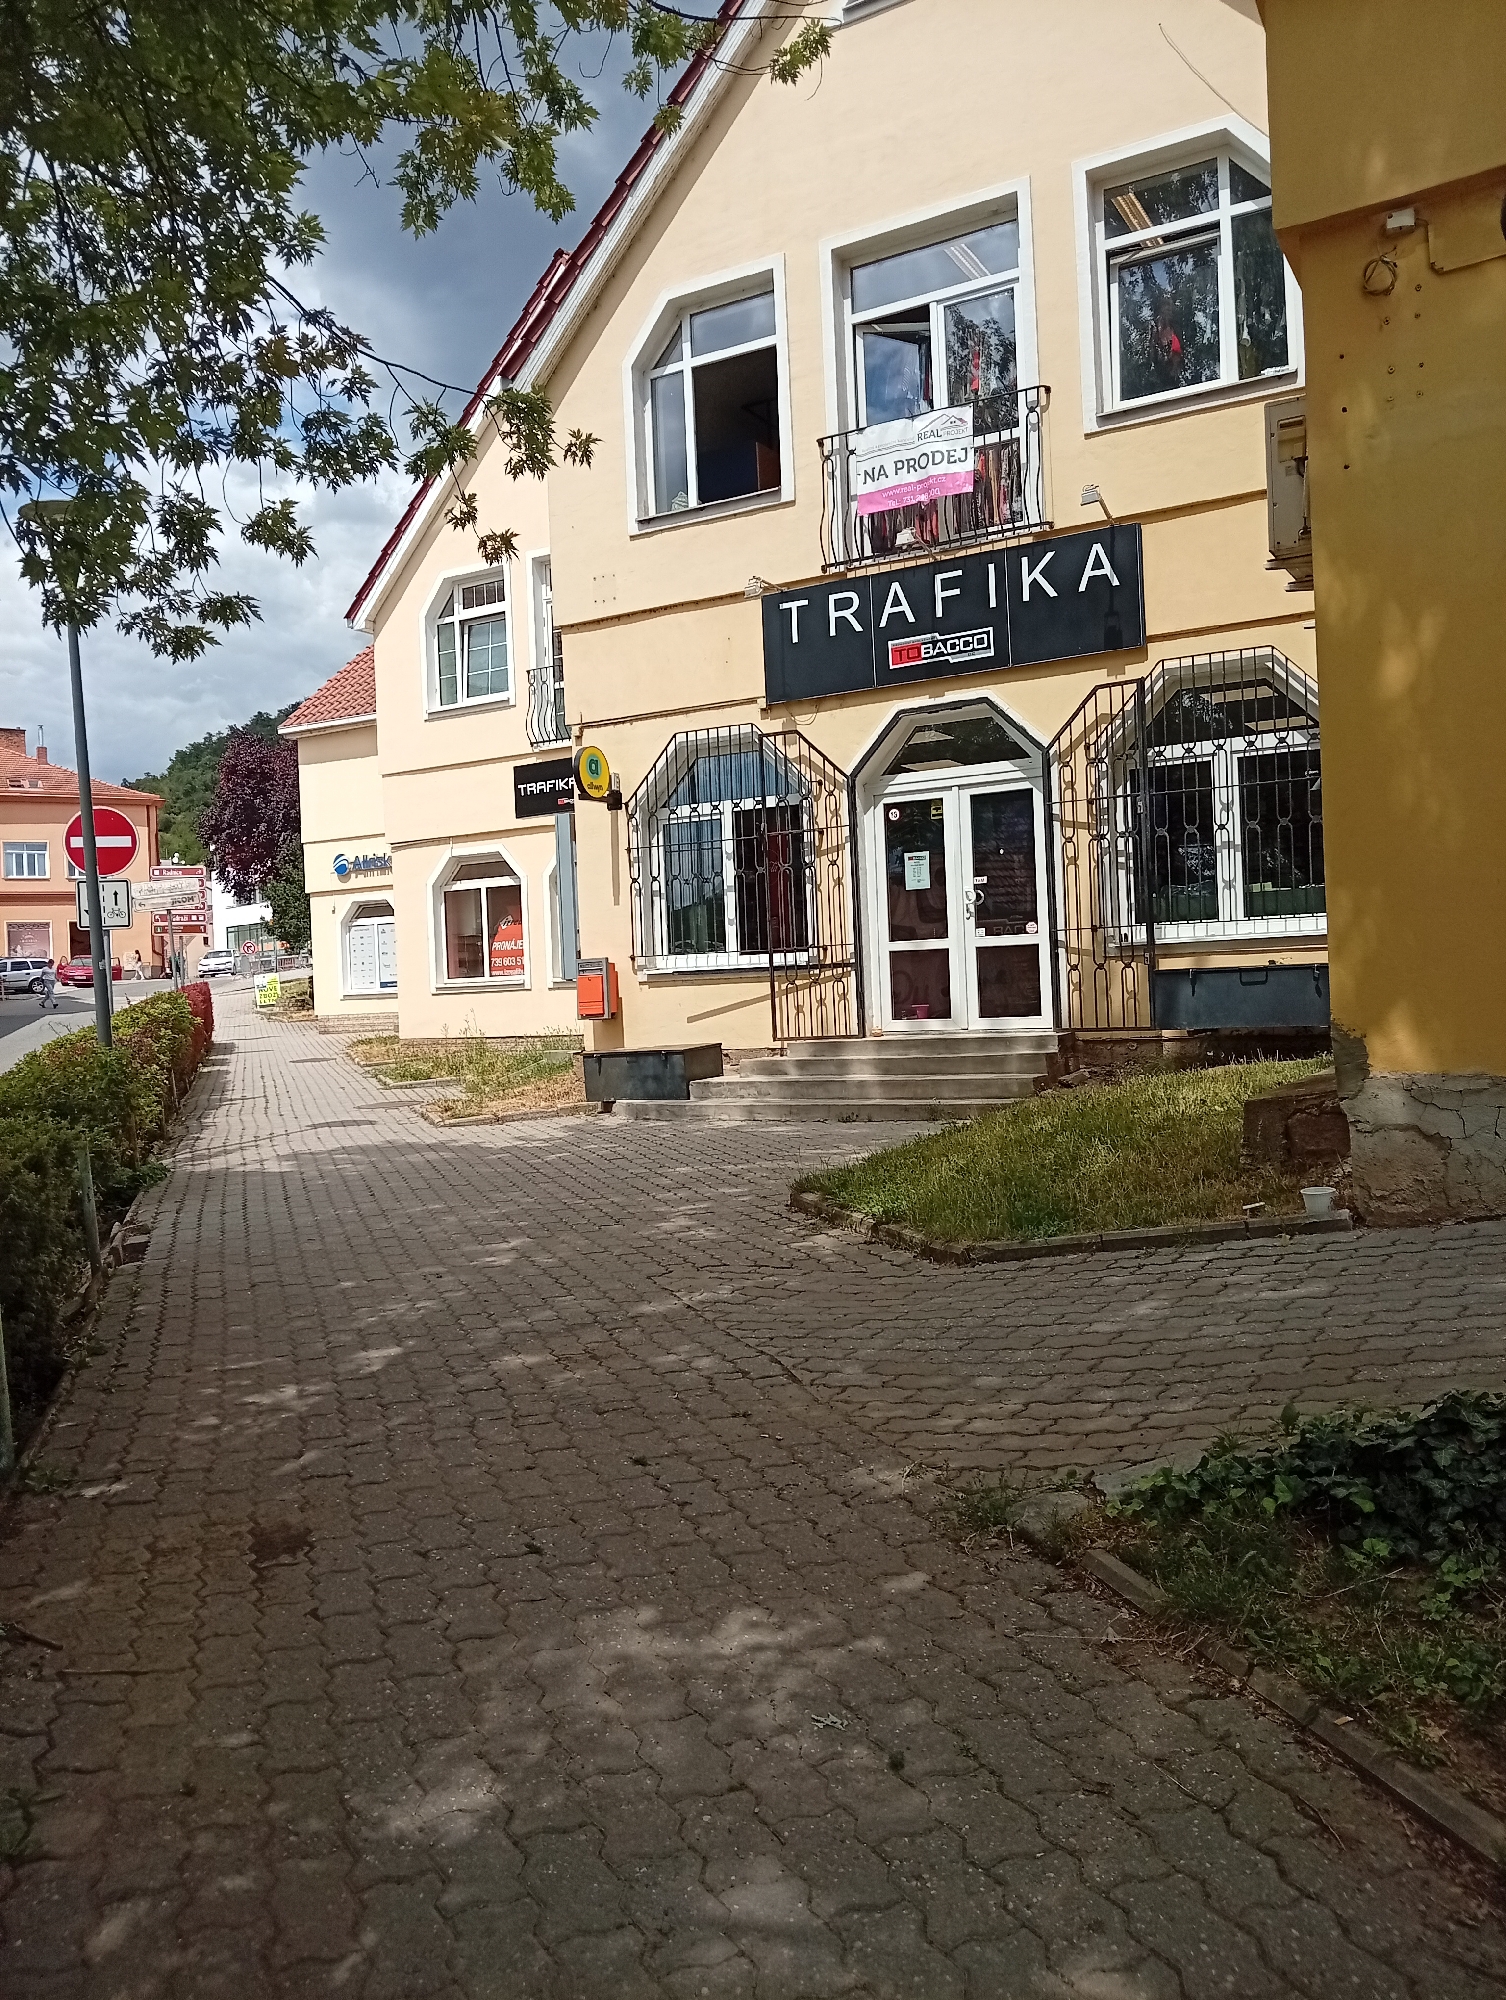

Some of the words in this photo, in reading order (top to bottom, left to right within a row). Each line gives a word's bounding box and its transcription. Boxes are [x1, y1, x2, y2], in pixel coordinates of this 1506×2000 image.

[917, 428, 942, 442] REAL
[943, 426, 969, 437] PROJEKT
[862, 464, 889, 485] NA
[893, 447, 968, 476] PRODEJ
[779, 542, 1121, 644] TRAFIKA
[893, 633, 988, 662] TOBACCO
[587, 781, 604, 793] allwyn
[491, 957, 503, 967] 739
[503, 956, 516, 967] 603
